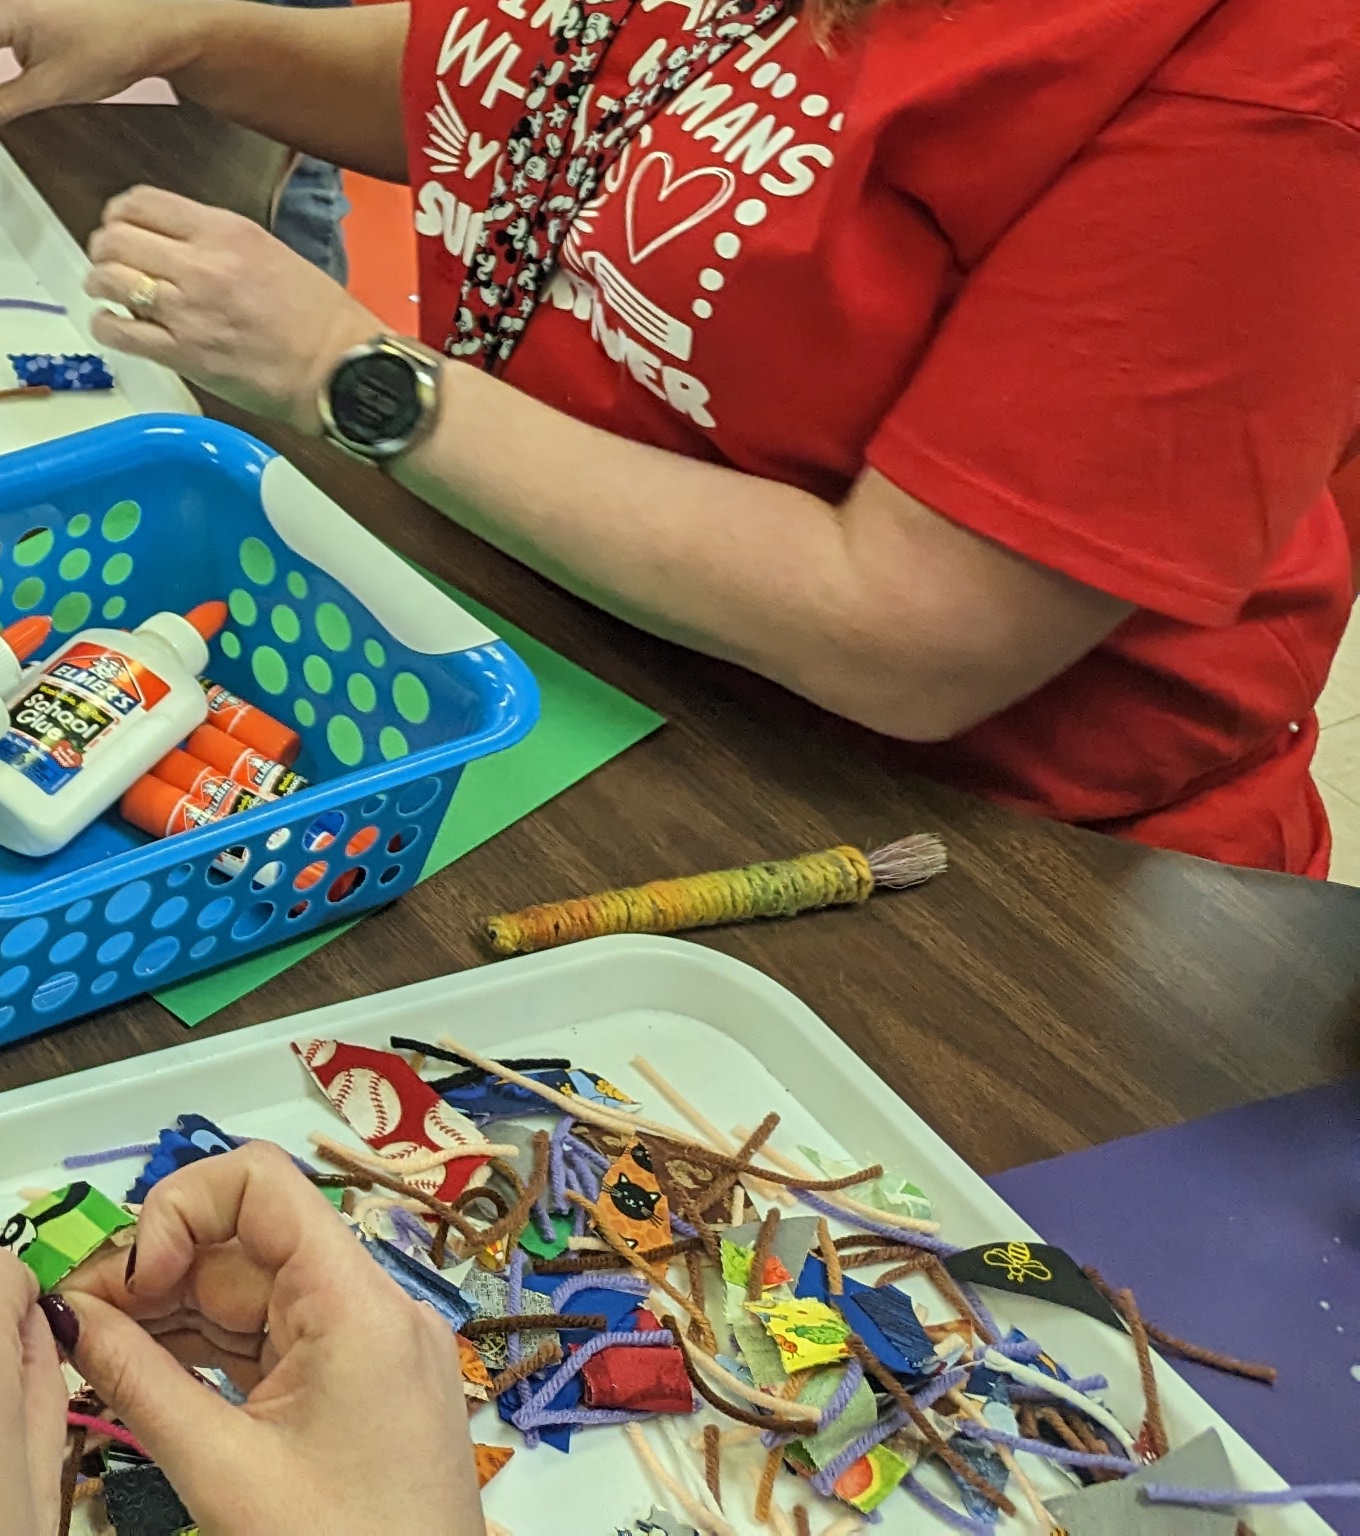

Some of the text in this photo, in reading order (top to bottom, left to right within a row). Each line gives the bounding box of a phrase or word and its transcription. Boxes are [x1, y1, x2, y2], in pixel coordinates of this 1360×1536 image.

[53, 664, 133, 711] ELMER'S
[15, 709, 65, 741] Glue
[23, 693, 101, 739] School
